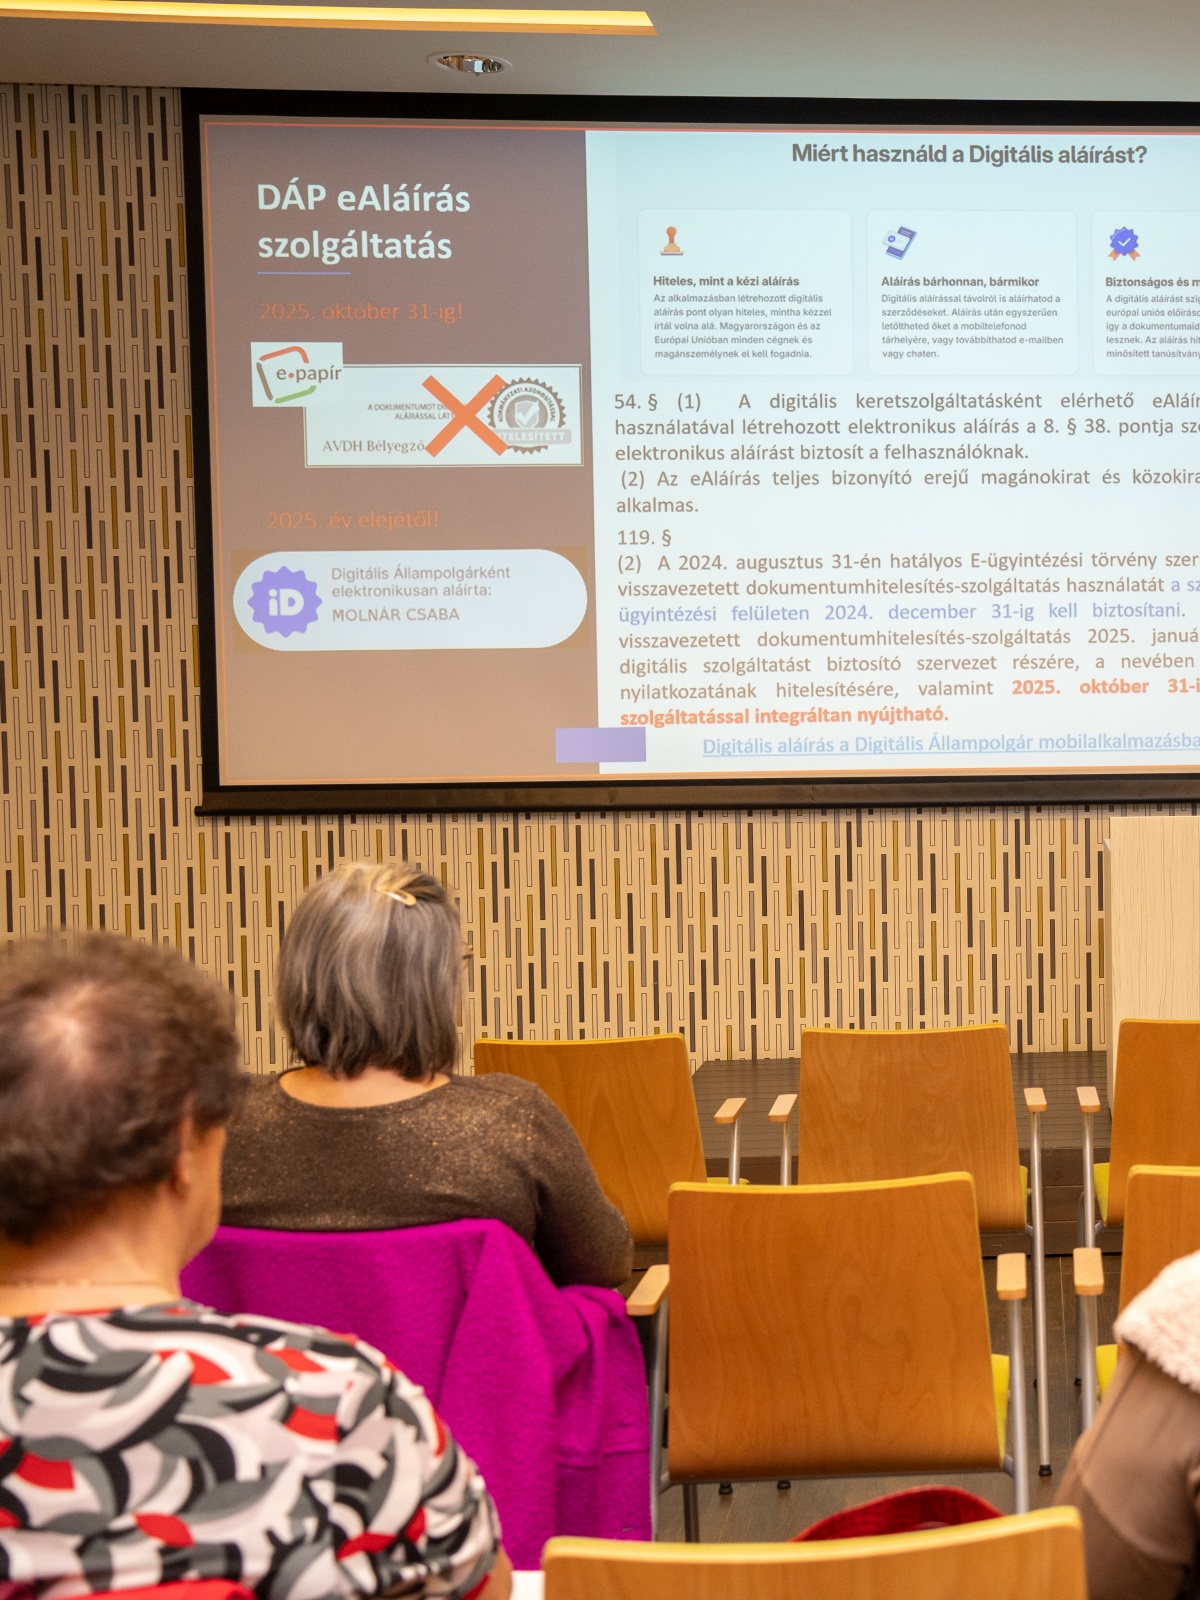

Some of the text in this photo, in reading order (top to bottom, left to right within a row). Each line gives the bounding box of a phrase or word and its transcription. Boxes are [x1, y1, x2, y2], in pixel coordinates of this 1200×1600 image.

[792, 144, 1148, 167] Miért használd a Digitális aláírást?
[257, 177, 471, 212] DÁP eAláírás
[258, 230, 453, 265] szolgáltatás
[653, 276, 697, 287] Hiteles,
[698, 276, 725, 285] mint
[736, 276, 760, 286] kézi
[761, 276, 800, 286] aláírás
[881, 277, 1040, 288] Aláírás bárhonnan, bármikor
[1105, 277, 1175, 289] Biztonságos
[1175, 277, 1190, 286] és
[653, 294, 824, 304] Az alkalmazásban létrehozott digitális
[260, 303, 463, 323] 2025. október 31-ig!
[653, 308, 832, 317] aláírás pont olyan hiteles, mintha kézzel
[881, 308, 1058, 318] szerződéseket. Aláírás után egyszerűen
[1105, 309, 1140, 318] európai
[881, 322, 930, 330] letöltheted
[931, 322, 951, 330] őket
[960, 322, 1027, 330] mobiltelefonod
[1105, 322, 1120, 332] így
[1128, 322, 1200, 330] dokumentumaid
[654, 336, 689, 345] Európai
[766, 336, 800, 345] cégnek
[881, 336, 930, 345] tárhelyére,
[1158, 336, 1189, 344] aláírás
[654, 350, 740, 359] magánszemélynek
[769, 350, 813, 359] fogadnia.
[882, 351, 905, 359] vagy
[374, 403, 435, 411] DOKUMENTUMOT
[614, 394, 641, 409] 54.
[647, 394, 658, 411] §
[677, 393, 701, 412] (1)
[738, 394, 752, 408] A
[769, 393, 837, 412] digitális
[856, 393, 1043, 411] keretszolgáltatásként
[1060, 392, 1134, 408] elérhető
[395, 412, 436, 420] ALÁÍRÁSSAL
[322, 440, 426, 453] AVDH Bélyegző
[615, 444, 1029, 460] elektronikus aláírást biztosít a felhasználóknak.
[616, 497, 699, 512] alkalmas.
[268, 511, 439, 531] 2025. év elejétől!
[617, 529, 672, 547] 119. §
[617, 555, 642, 574] (2)
[657, 556, 671, 570] A
[678, 555, 727, 570] 2024.
[736, 556, 824, 573] augusztus
[831, 553, 881, 568] 31-én
[890, 553, 963, 571] hatályos
[970, 553, 1083, 571] E-ügyintézési
[1090, 553, 1158, 570] törvény
[331, 565, 511, 583] Digitális Állampolgárként
[331, 583, 492, 597] elektronikusan aláírta:
[617, 582, 740, 596] visszavezetett
[745, 578, 1061, 596] dokumentumhitelesítés-szolgáltatás
[1066, 577, 1165, 592] használatát
[1171, 581, 1180, 591] a
[268, 588, 305, 616] iD
[332, 607, 460, 621] MOLNÁR CSABA
[618, 634, 741, 648] visszavezetett
[757, 629, 1071, 647] dokumentumhitelesítés-szolgáltatás
[1087, 629, 1135, 643] 2025.
[620, 683, 757, 703] nyilatkozatának
[776, 682, 899, 699] hitelesítésére,
[917, 681, 994, 695] valamint
[1011, 680, 1061, 694] 2025.
[1079, 679, 1150, 694] október
[619, 706, 949, 728] szolgáltatással integráltan nyújtható.
[703, 738, 772, 756] Digitális
[777, 737, 834, 753] aláírás
[840, 740, 849, 752] a
[855, 736, 924, 754] Digitális
[928, 732, 1033, 752] Állampolgár
